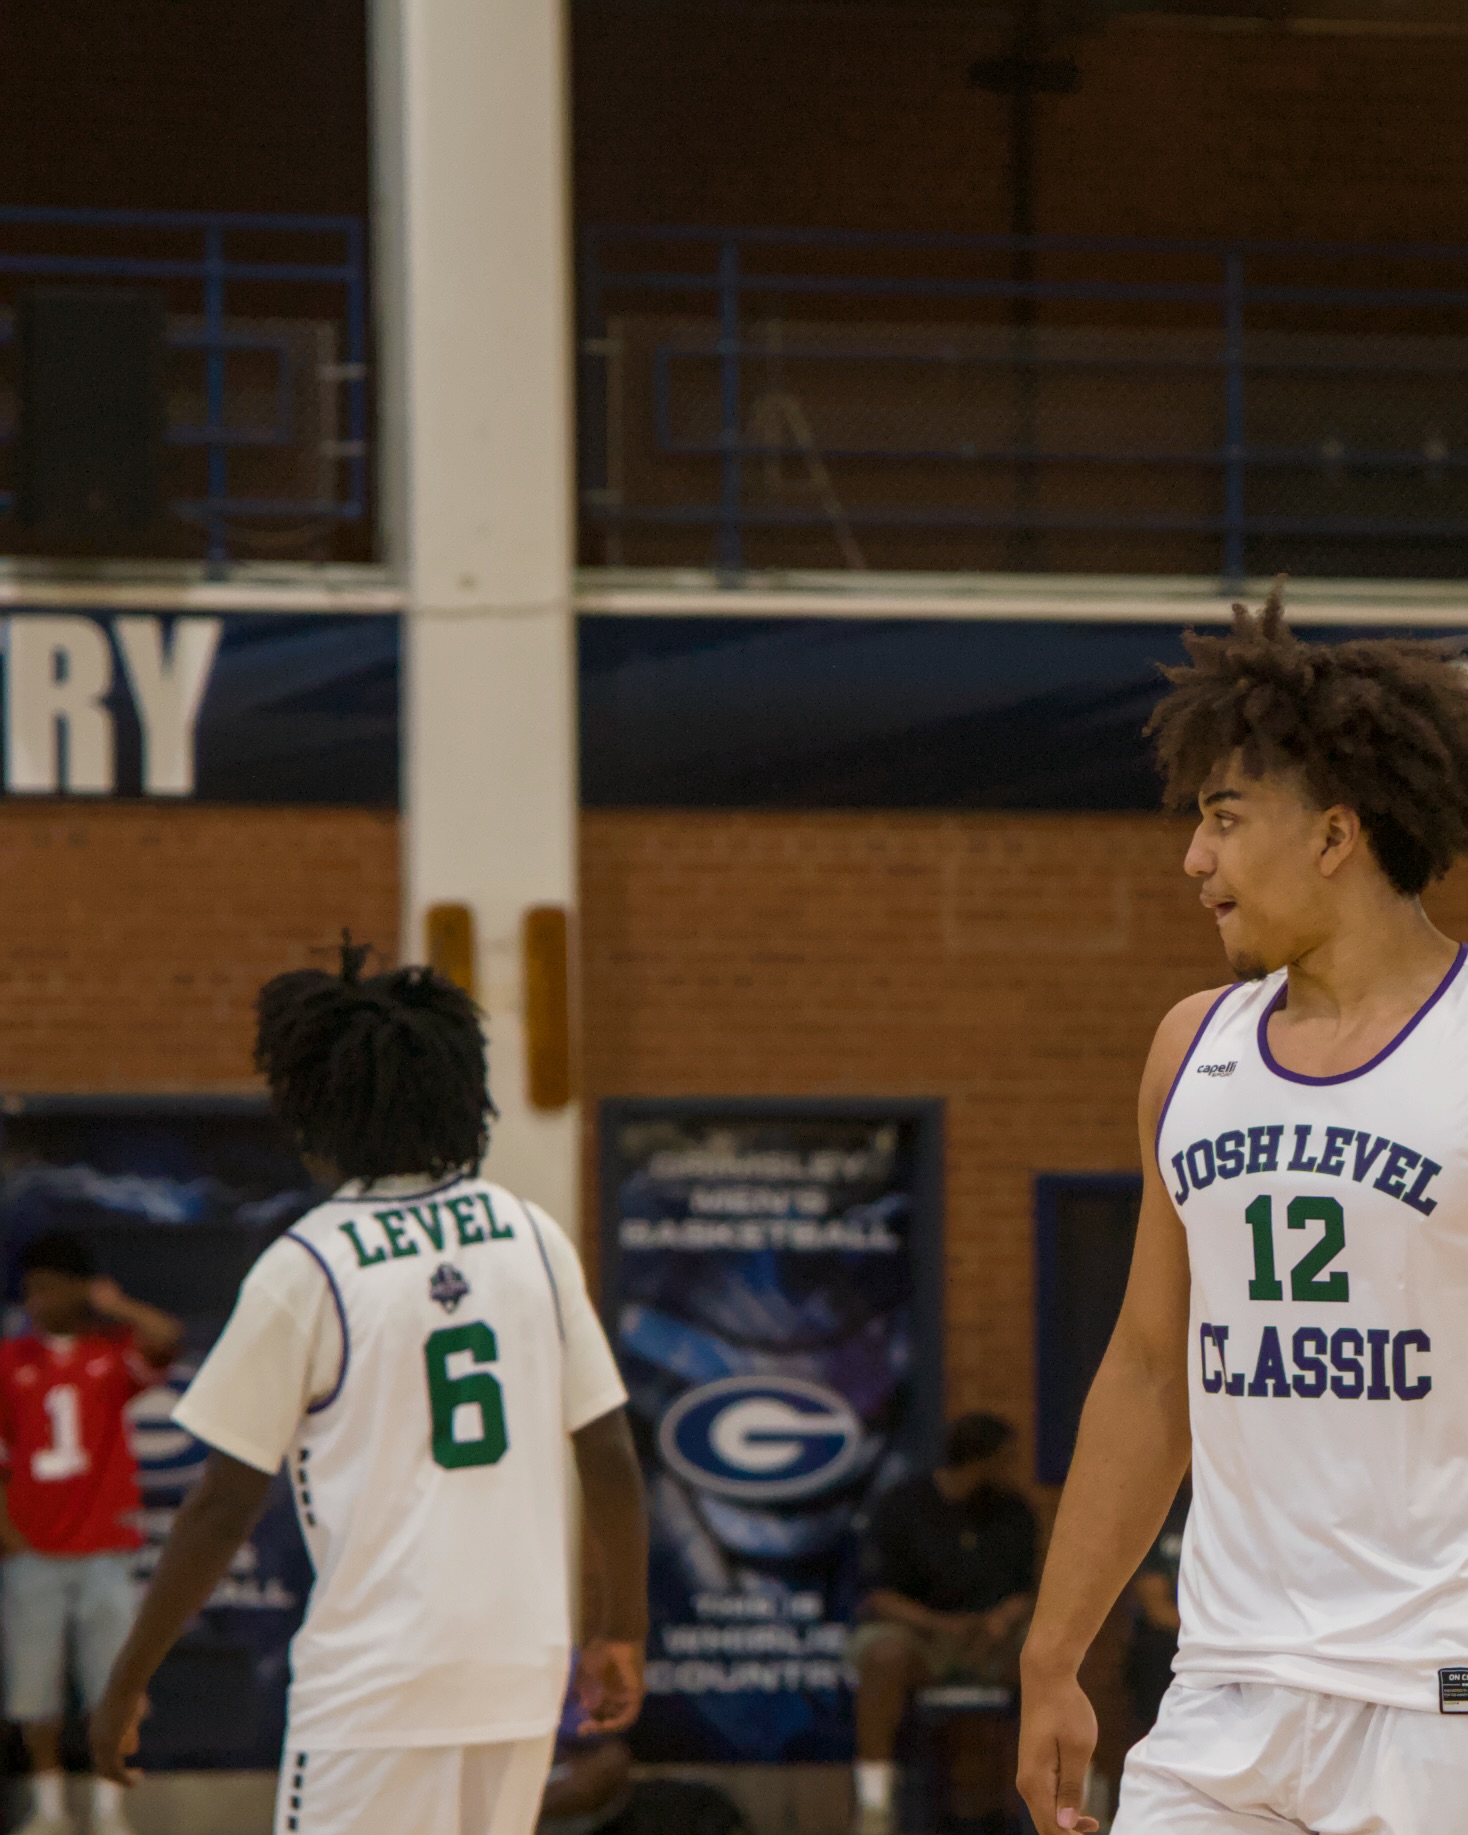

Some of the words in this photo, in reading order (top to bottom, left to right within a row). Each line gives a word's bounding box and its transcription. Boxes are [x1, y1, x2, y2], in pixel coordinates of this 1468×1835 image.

[0, 612, 223, 795] RY
[1197, 1060, 1238, 1077] capelli
[1171, 1124, 1285, 1206] JOSH
[1286, 1123, 1444, 1218] LEVEL
[338, 1191, 515, 1269] LEVEL
[1244, 1194, 1350, 1303] 12
[424, 1319, 509, 1470] 6
[1199, 1321, 1433, 1401] CLASSIC
[30, 1383, 91, 1483] 1
